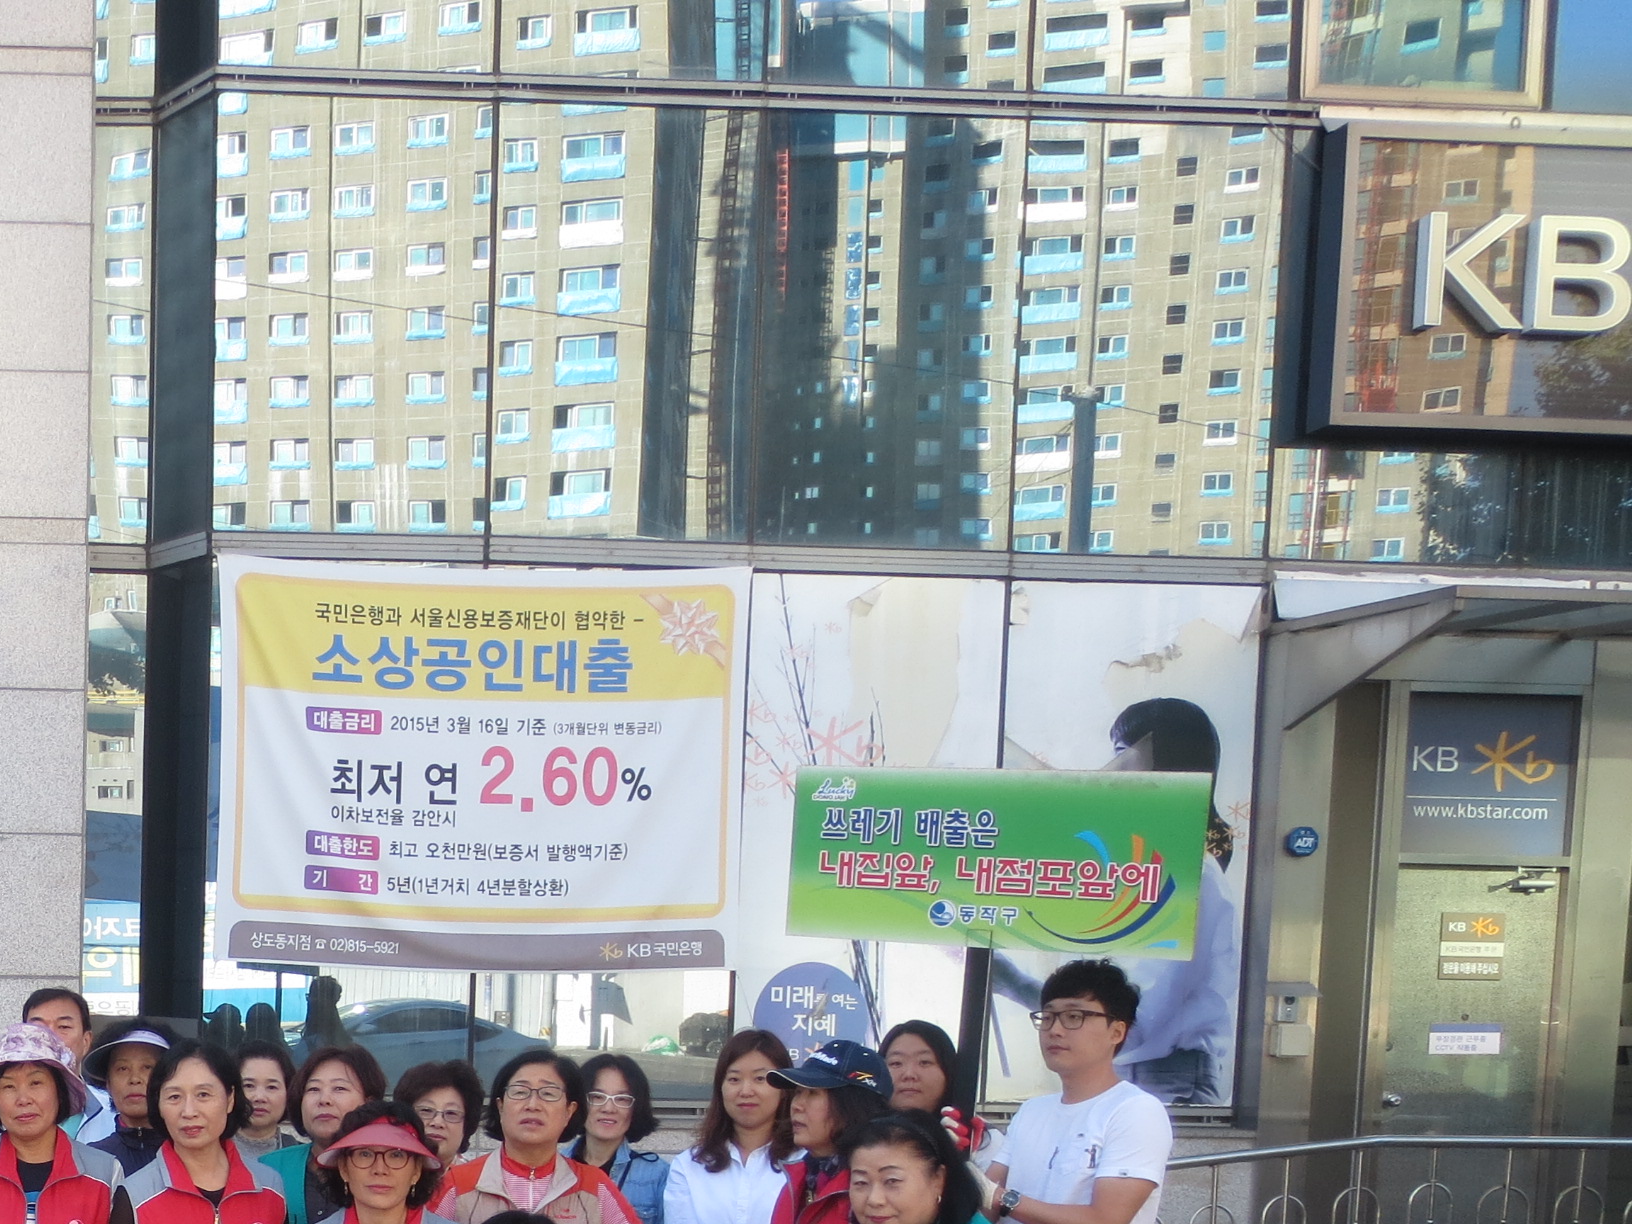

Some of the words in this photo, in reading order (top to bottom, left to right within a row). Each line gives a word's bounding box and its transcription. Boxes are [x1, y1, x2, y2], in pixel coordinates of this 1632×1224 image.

[1413, 211, 1632, 335] KB
[314, 602, 402, 626] 국민은행과
[410, 606, 566, 631] 서울신용보증재단이
[574, 610, 626, 631] 협약한
[312, 633, 634, 693] 소상공인대출
[313, 708, 376, 732] 대출금리
[390, 714, 440, 734] 2015년
[447, 715, 471, 735] 3월
[478, 715, 509, 735] 16일
[516, 716, 547, 736] 기준
[552, 721, 609, 736] (3개월단위
[613, 721, 662, 736] 변동금리)
[1413, 745, 1459, 773] KB
[330, 759, 403, 805] 최저
[424, 762, 458, 806] 연
[330, 805, 405, 827] 이차보전율
[411, 807, 457, 828] 감안시
[1412, 803, 1549, 822] www.kbstar.com
[821, 807, 902, 843] 쓰레기
[915, 808, 1000, 849] 배출은
[314, 834, 374, 857] 대출한도
[388, 840, 419, 858] 최고
[424, 842, 539, 862] 오천만원(보증서
[546, 842, 628, 861] 발행액기준)
[1294, 837, 1315, 849] ADT
[386, 876, 470, 896] 5년(1년거치
[476, 877, 570, 898] 4년분할상환)
[817, 849, 942, 896] 내집앞,
[954, 853, 1161, 905] 내점포앞에
[957, 905, 1019, 926] 동작구
[1448, 921, 1466, 933] KB
[250, 931, 311, 951] 상도동지점
[329, 937, 400, 955] 02)815-5921
[831, 994, 859, 1010] 여는
[791, 1014, 837, 1037] 지혜
